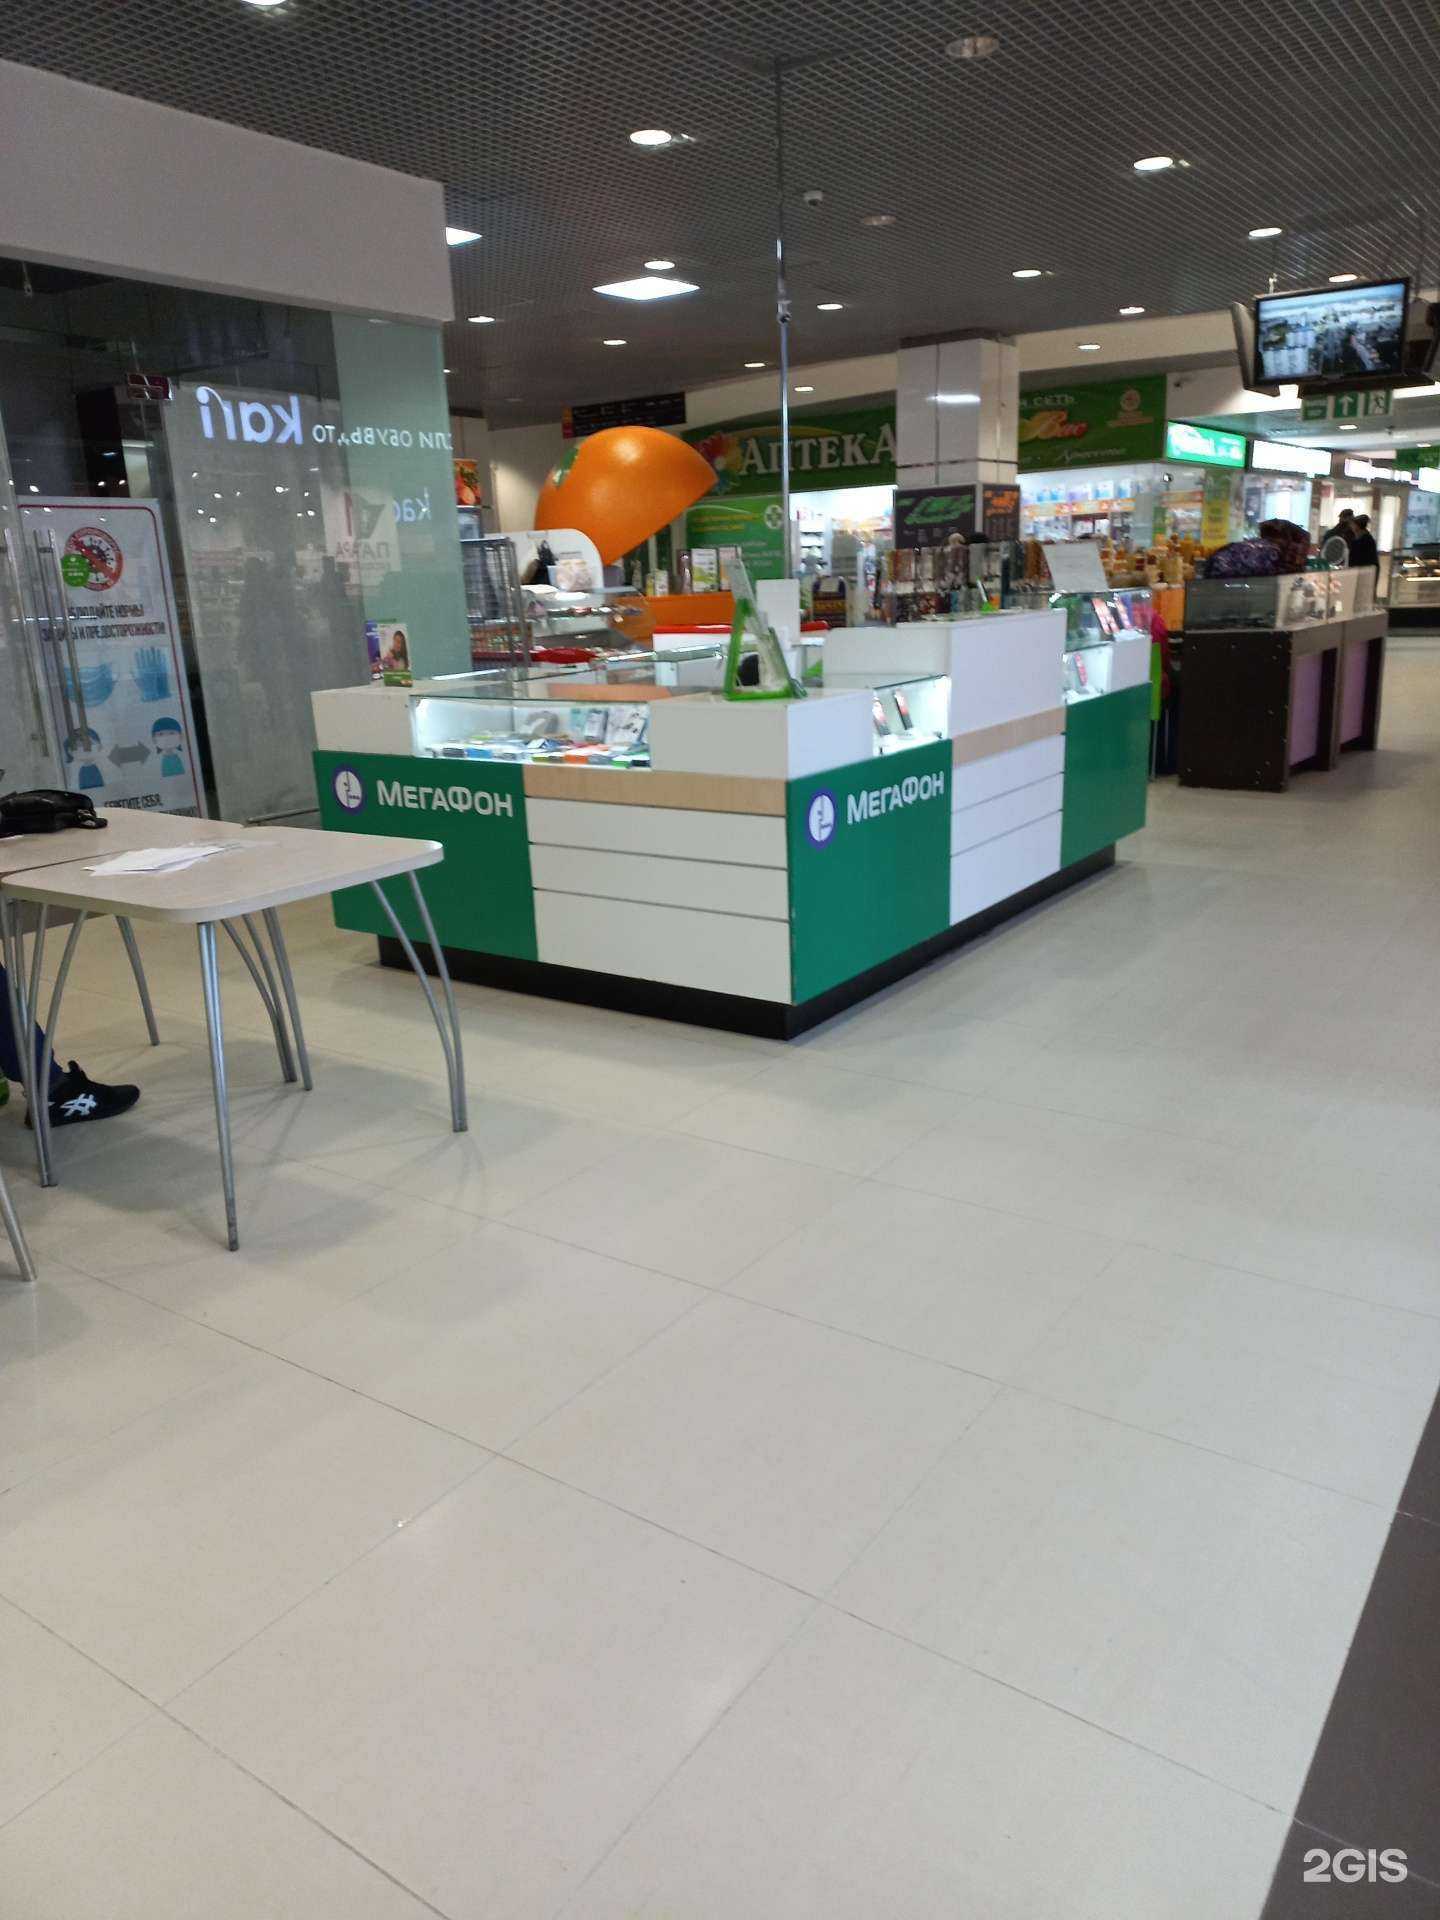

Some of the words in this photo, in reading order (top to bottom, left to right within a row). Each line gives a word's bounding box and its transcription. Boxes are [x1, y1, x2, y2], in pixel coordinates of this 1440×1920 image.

[739, 422, 897, 475] АПТЕКА
[376, 779, 514, 818] МЕГАФОН
[847, 771, 945, 825] МЕГАФОН
